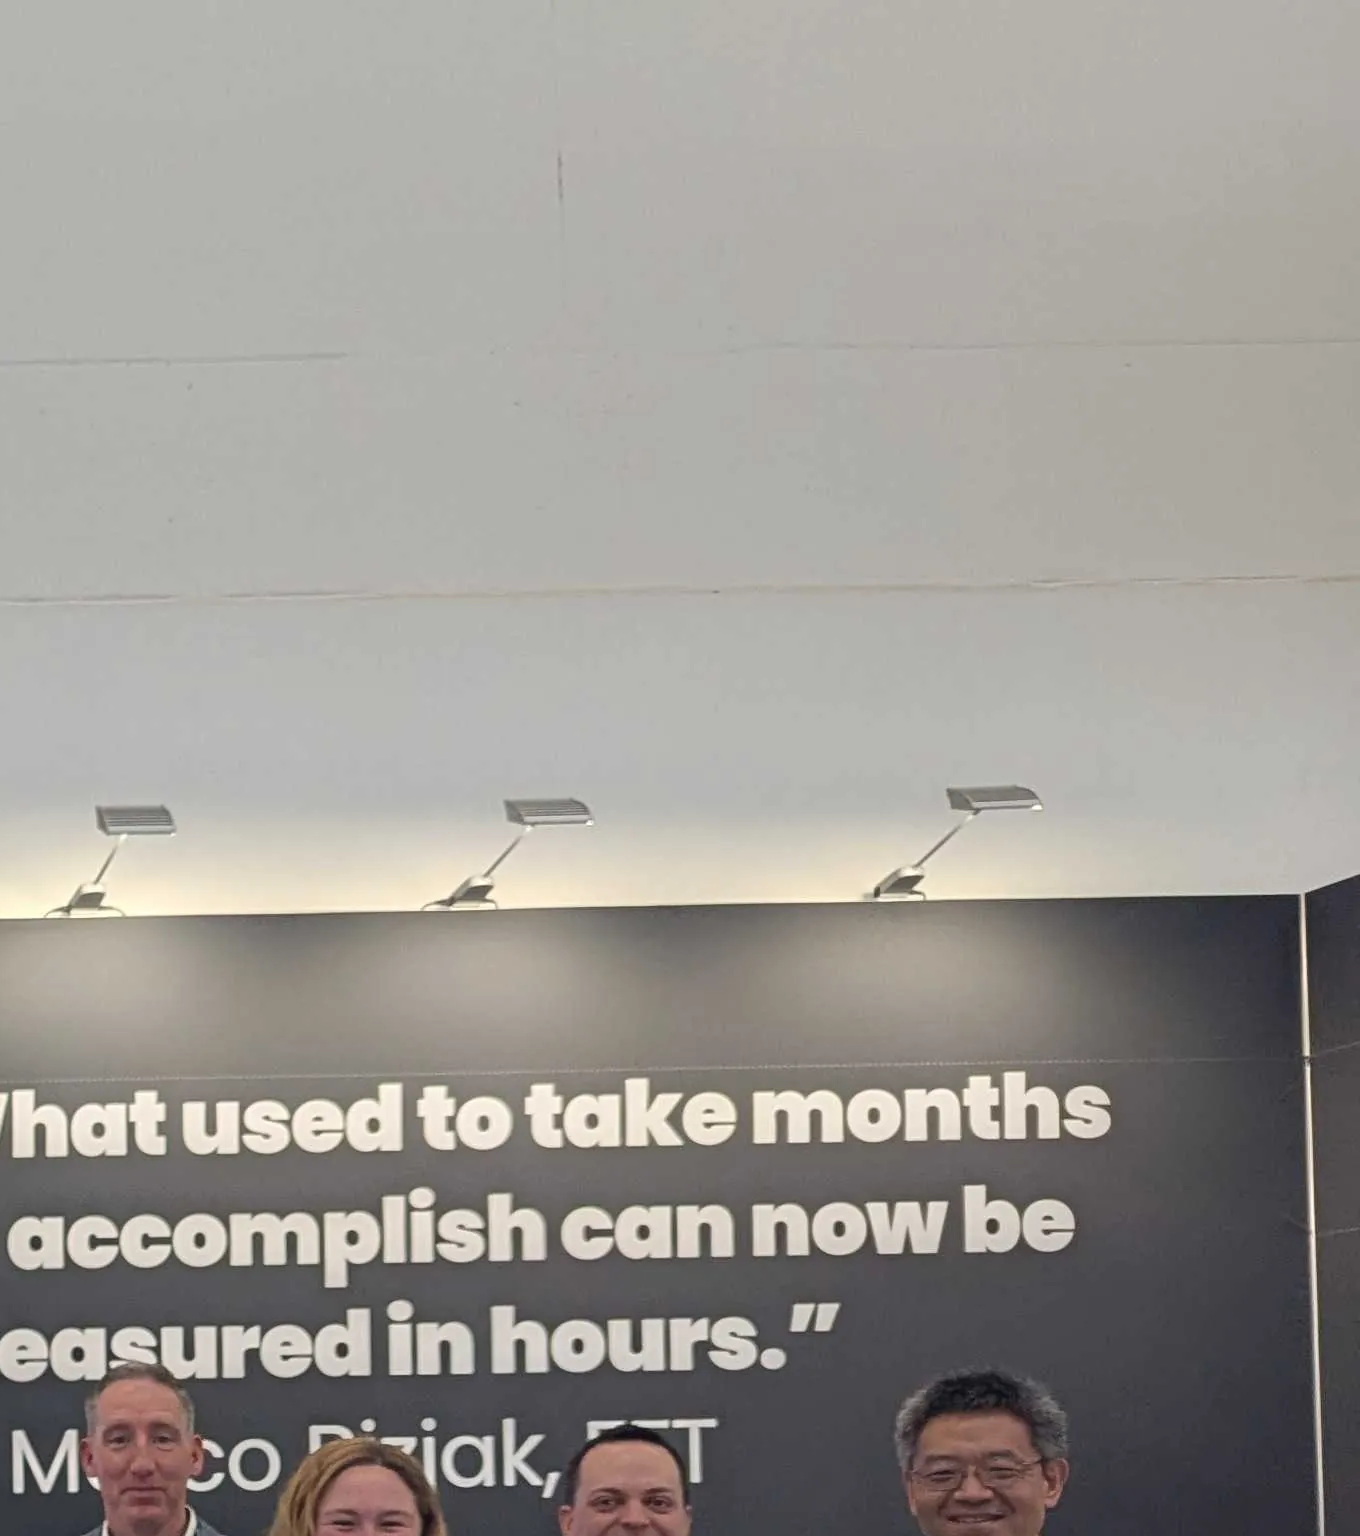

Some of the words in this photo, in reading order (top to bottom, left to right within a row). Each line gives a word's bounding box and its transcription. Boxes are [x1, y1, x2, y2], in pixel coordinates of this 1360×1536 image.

[182, 1082, 403, 1155] used
[416, 1085, 513, 1151] to
[524, 1077, 737, 1149] take
[752, 1070, 1112, 1145] months
[7, 1186, 547, 1288] accomplish
[560, 1204, 735, 1260] can
[751, 1200, 949, 1257] now
[963, 1184, 1076, 1253] be
[386, 1299, 475, 1376] in
